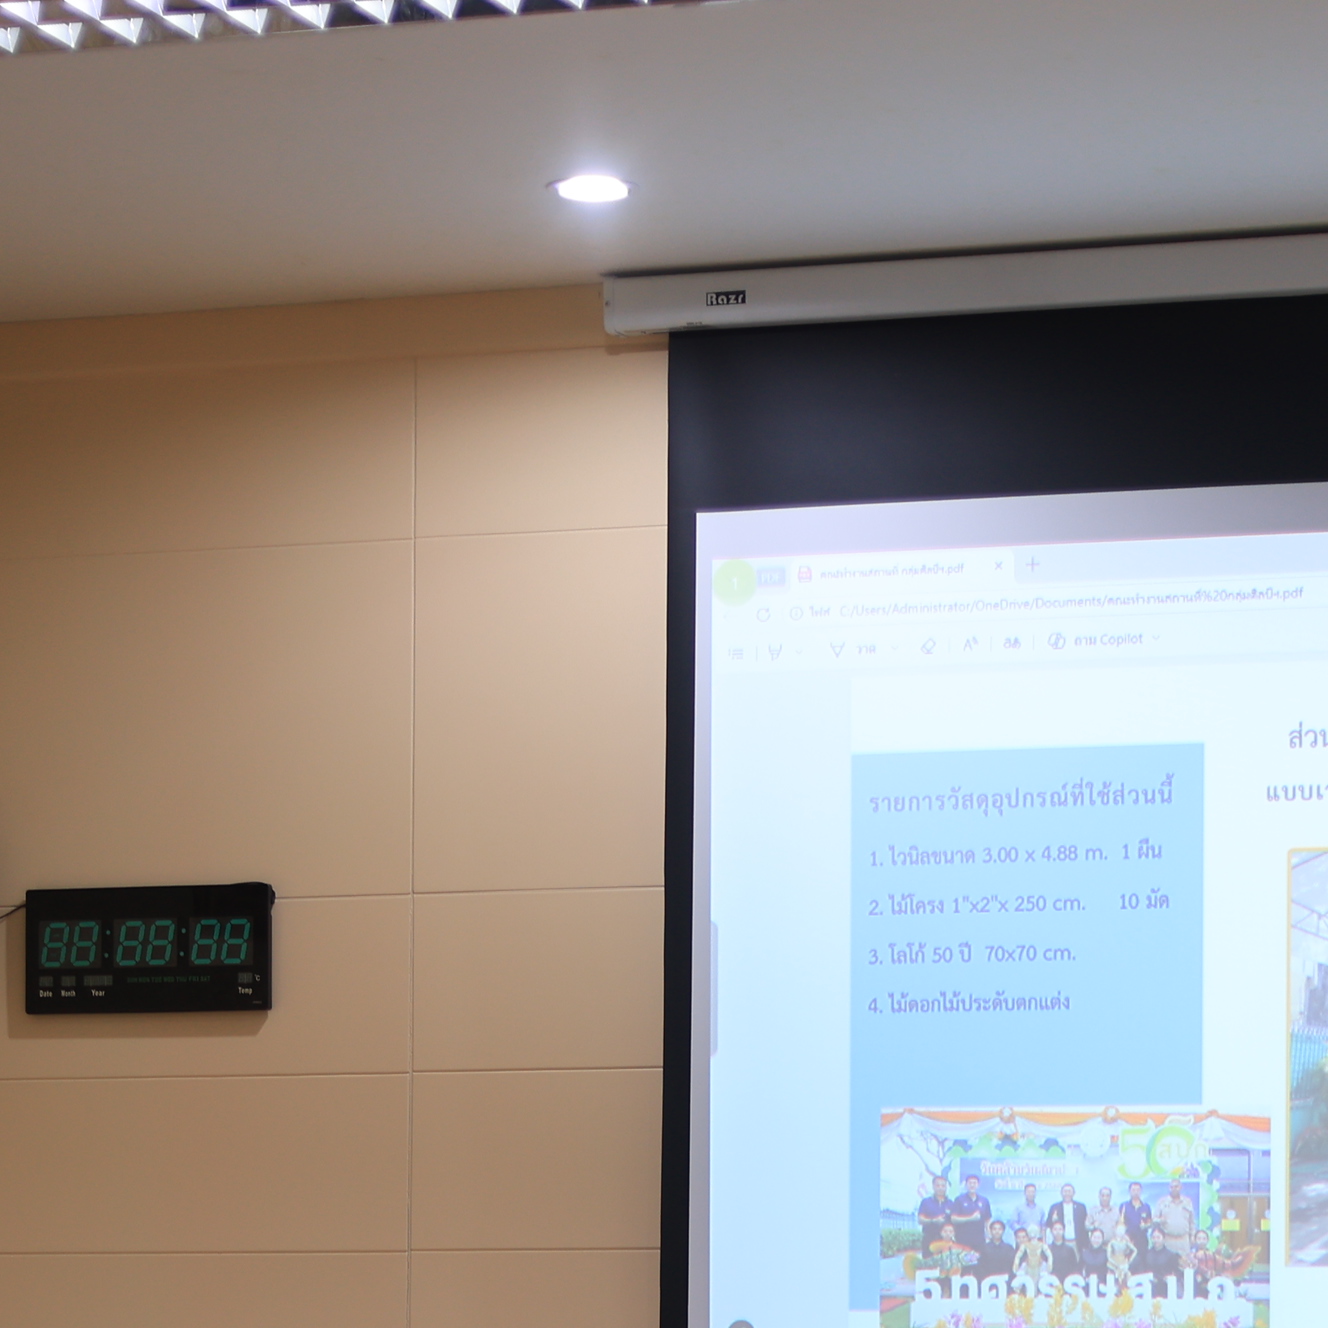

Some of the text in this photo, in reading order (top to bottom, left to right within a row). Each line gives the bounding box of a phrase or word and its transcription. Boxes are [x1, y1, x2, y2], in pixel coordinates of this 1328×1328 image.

[707, 292, 745, 306] Razr
[1100, 632, 1143, 648] Copilot
[869, 773, 1175, 817] รายการวัสดุอุปกรณ์ที่ใช้ส่วนนี้
[870, 851, 884, 867] 1.
[889, 845, 976, 867] ไวนิลขนาด
[983, 847, 1019, 864] 3.00
[1025, 851, 1035, 863] x
[1041, 845, 1079, 862] 4.88
[1085, 848, 1108, 862] m.
[1122, 845, 1129, 861] 1
[868, 900, 884, 916] 2.
[888, 893, 944, 917] ไม้โครง
[1014, 896, 1047, 913] 250
[1052, 899, 1086, 912] cm.
[1119, 893, 1140, 910] 10
[1146, 887, 1170, 911] มัด
[868, 941, 1076, 965] 3. โลโก้ 50 ปี 70x70 cm.
[39, 990, 53, 998] Date
[91, 989, 105, 997] Year
[238, 986, 253, 995] Temp
[868, 990, 1071, 1014] 4. ไม้ดอกไม้ประดับตกแต่ง
